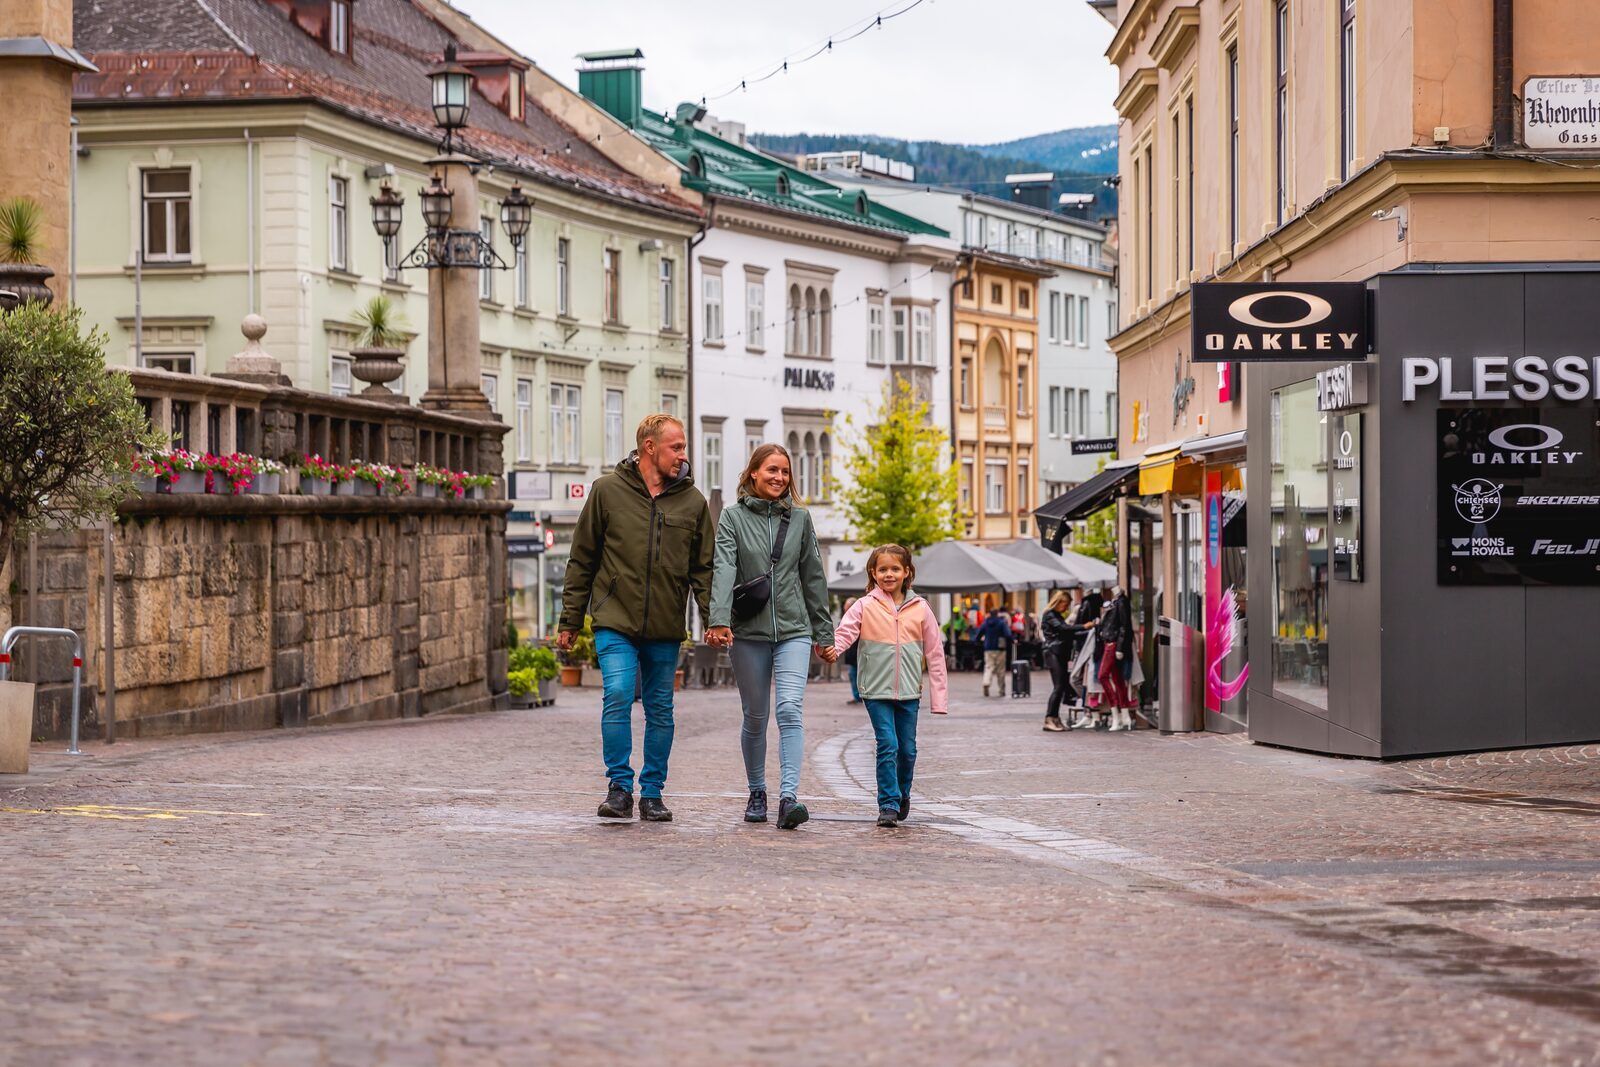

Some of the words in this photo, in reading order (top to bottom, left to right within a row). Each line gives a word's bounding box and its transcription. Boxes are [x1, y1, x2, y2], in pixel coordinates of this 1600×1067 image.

[1558, 129, 1600, 144] Gass
[1206, 333, 1358, 350] OAKLEY
[1472, 452, 1577, 464] OAKLEY
[1516, 496, 1600, 505] SKECHERS
[1471, 538, 1505, 546] MONS
[1471, 547, 1515, 556] ROYALE
